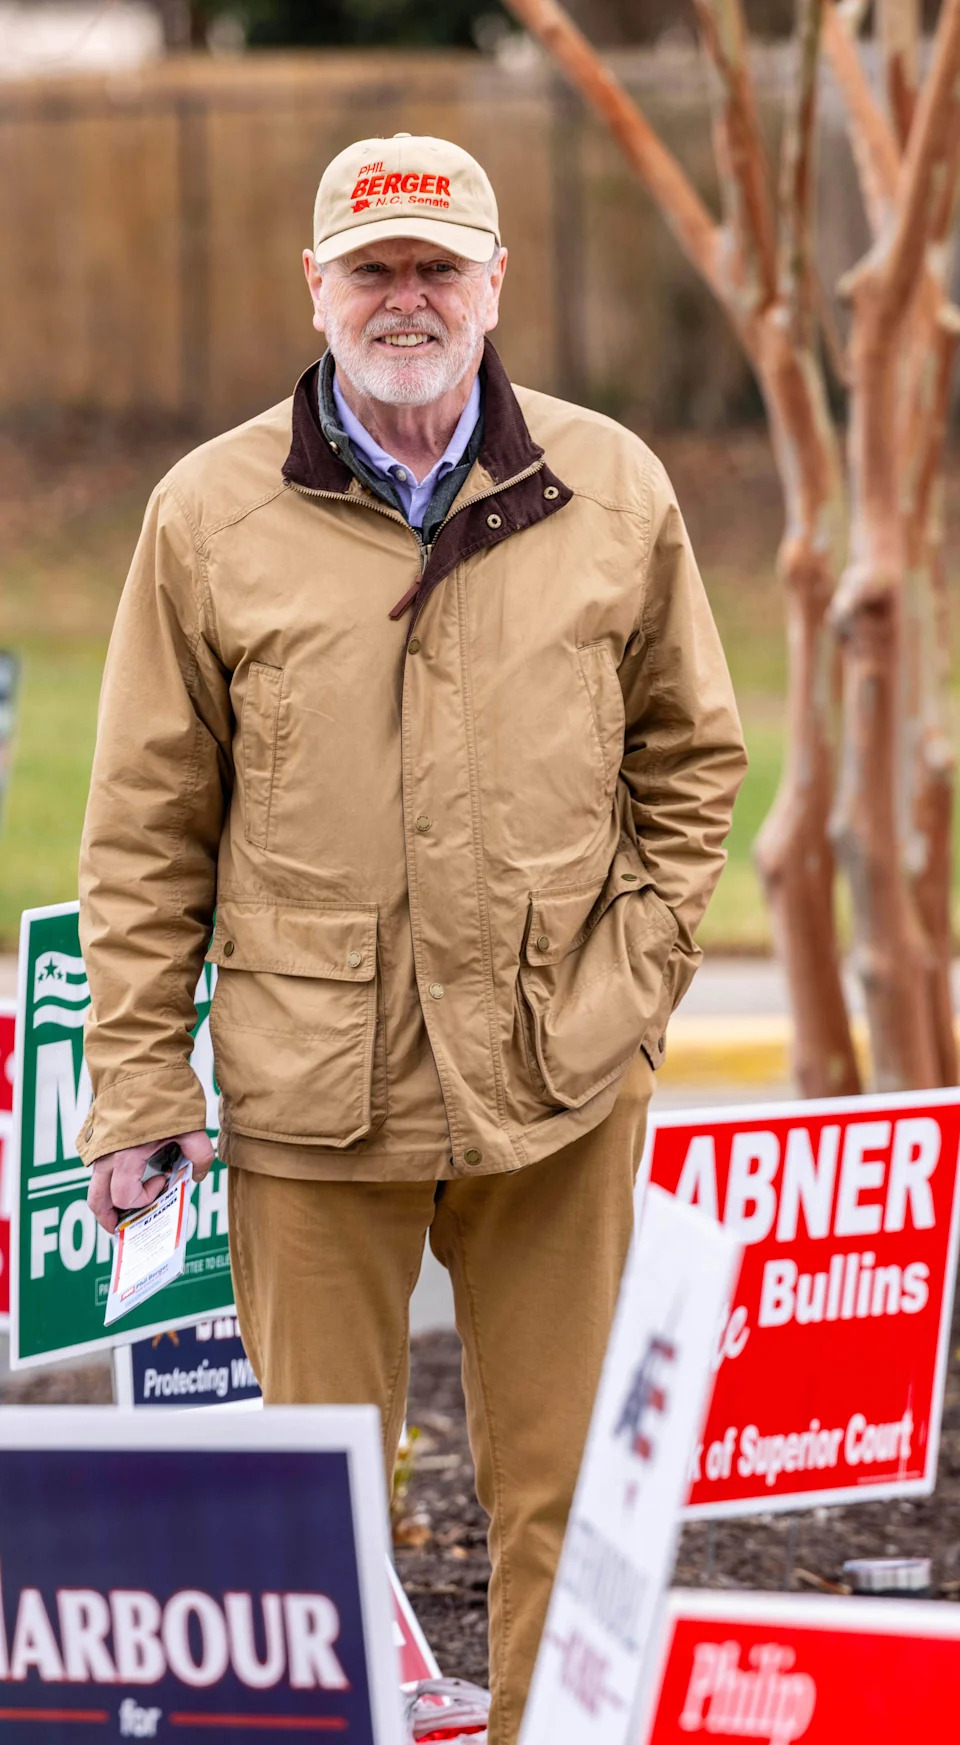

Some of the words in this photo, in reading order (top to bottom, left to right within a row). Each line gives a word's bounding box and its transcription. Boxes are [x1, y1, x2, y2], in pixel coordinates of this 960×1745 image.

[350, 172, 451, 200] BERGER
[358, 161, 386, 178] PHIL
[376, 196, 403, 207] N.C.
[408, 195, 450, 209] Senate
[673, 1116, 942, 1246] ABNER
[758, 1251, 930, 1328] Bullins
[143, 1358, 229, 1399] Protecting
[705, 1426, 738, 1482] of
[737, 1418, 844, 1487] Superior
[844, 1406, 914, 1466] Court
[0, 1584, 350, 1690] ARBOUR
[118, 1697, 162, 1738] for
